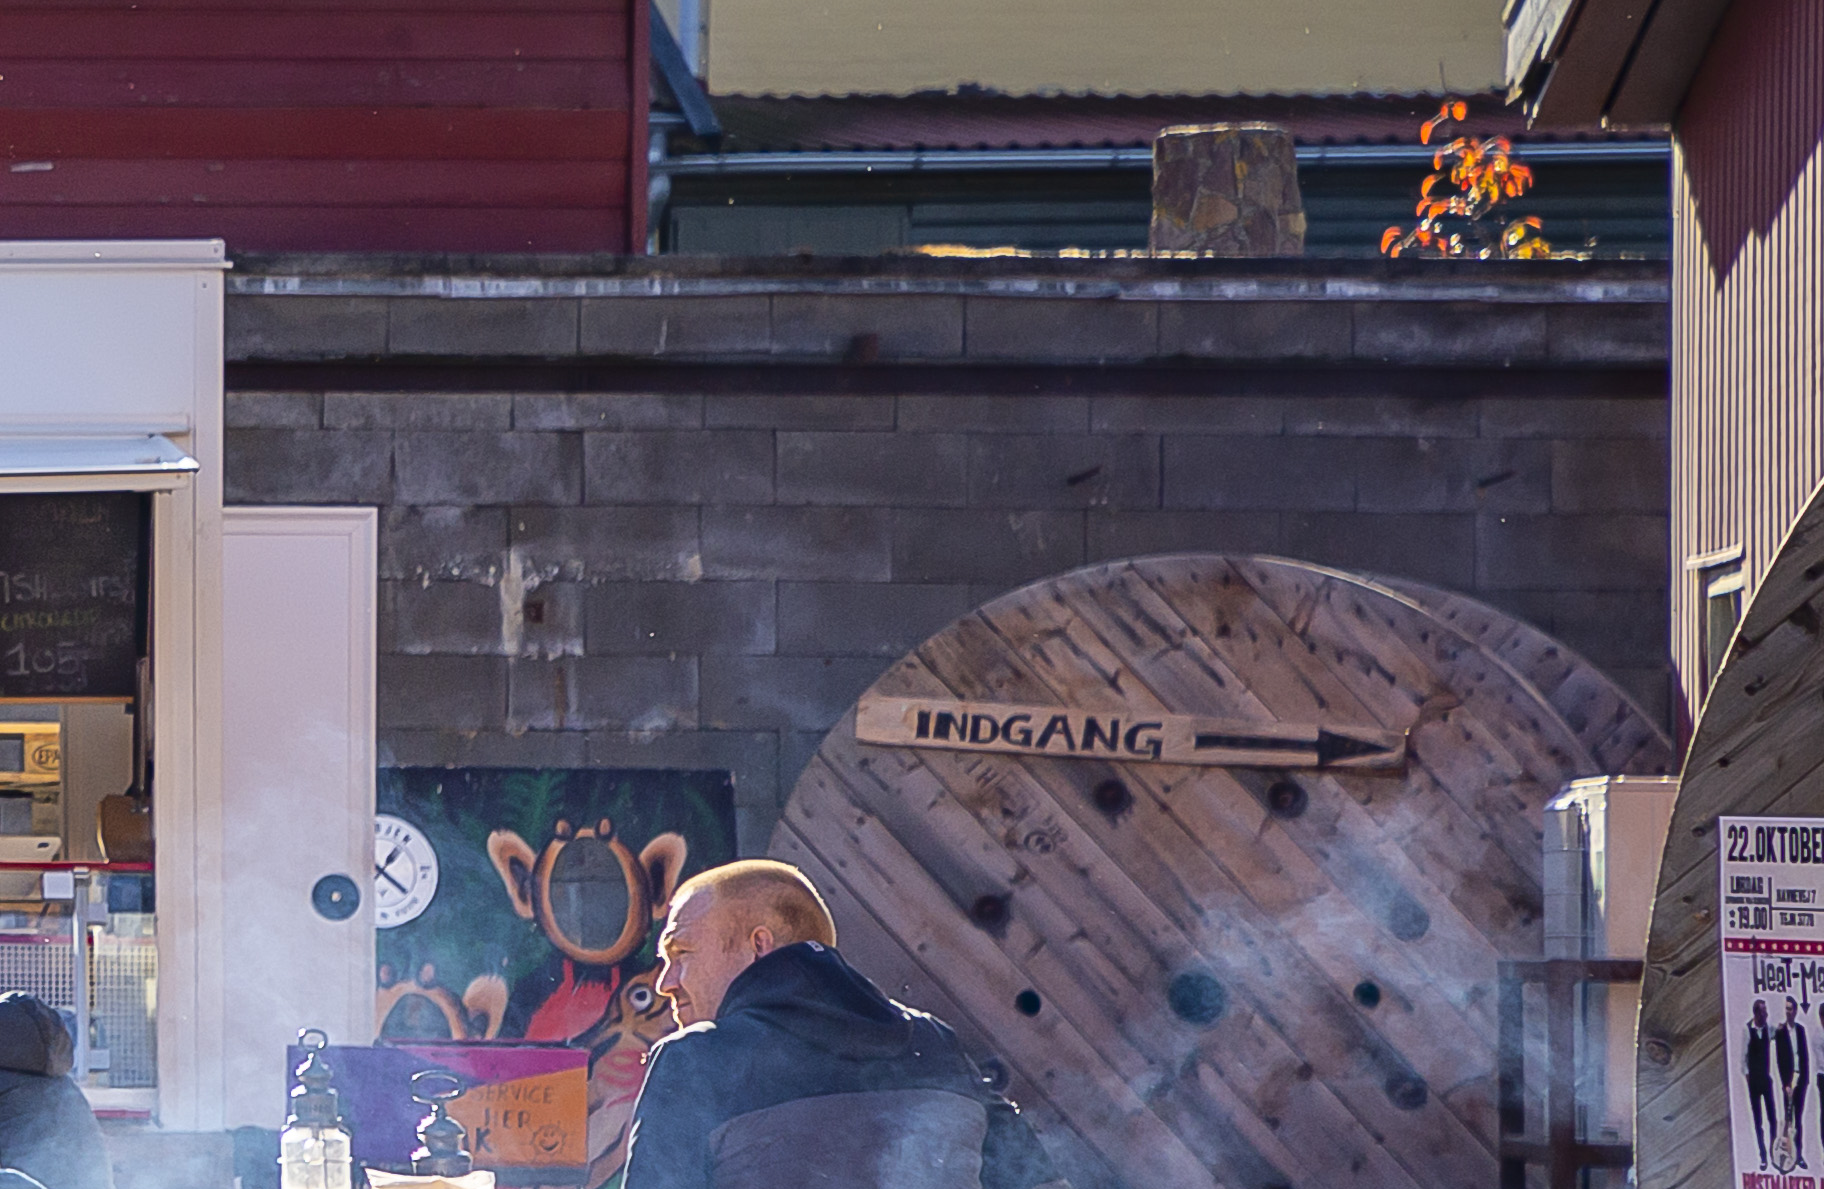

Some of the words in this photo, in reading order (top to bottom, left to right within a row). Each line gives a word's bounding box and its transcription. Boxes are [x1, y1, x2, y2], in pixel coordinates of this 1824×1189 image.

[914, 709, 1165, 760] INDGANG
[1726, 824, 1824, 864] 22.OKTOBE
[471, 1082, 554, 1105] SERVICE
[484, 1107, 531, 1129] HER
